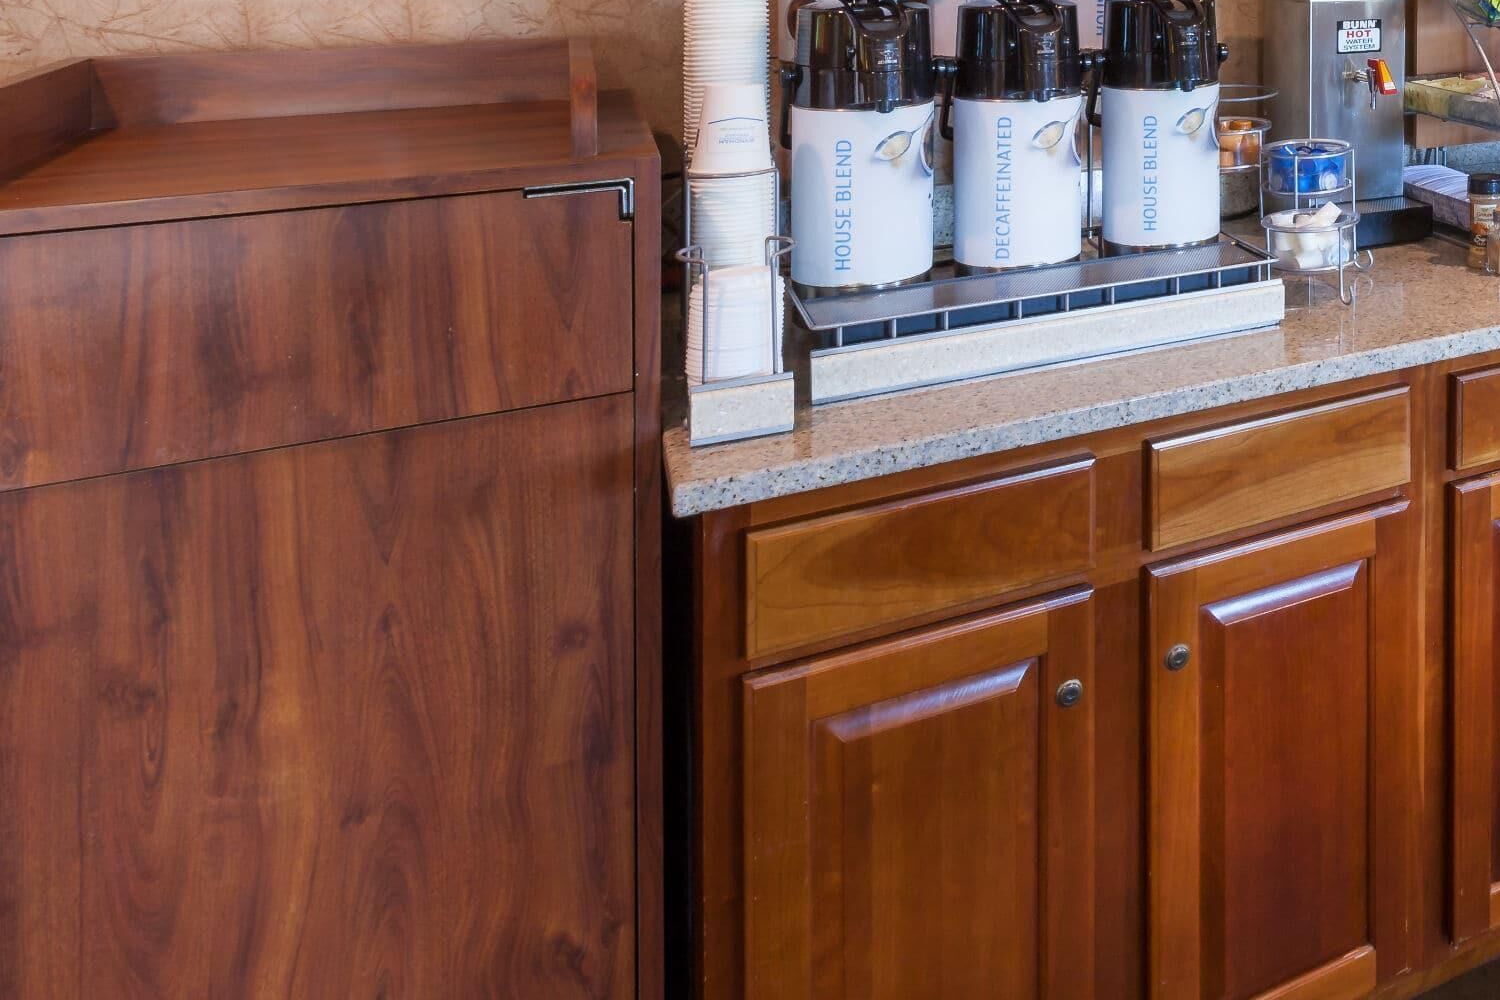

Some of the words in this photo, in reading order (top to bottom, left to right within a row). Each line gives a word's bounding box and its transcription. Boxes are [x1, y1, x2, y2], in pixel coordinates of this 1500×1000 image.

[1342, 19, 1376, 29] BUNN
[1346, 30, 1372, 38] HOT
[835, 139, 852, 202] BLEND
[1143, 115, 1158, 170] BLEND
[995, 116, 1013, 260] DECAFFEINATED
[1143, 175, 1158, 231] HOUSE
[834, 207, 852, 272] HOUSE
